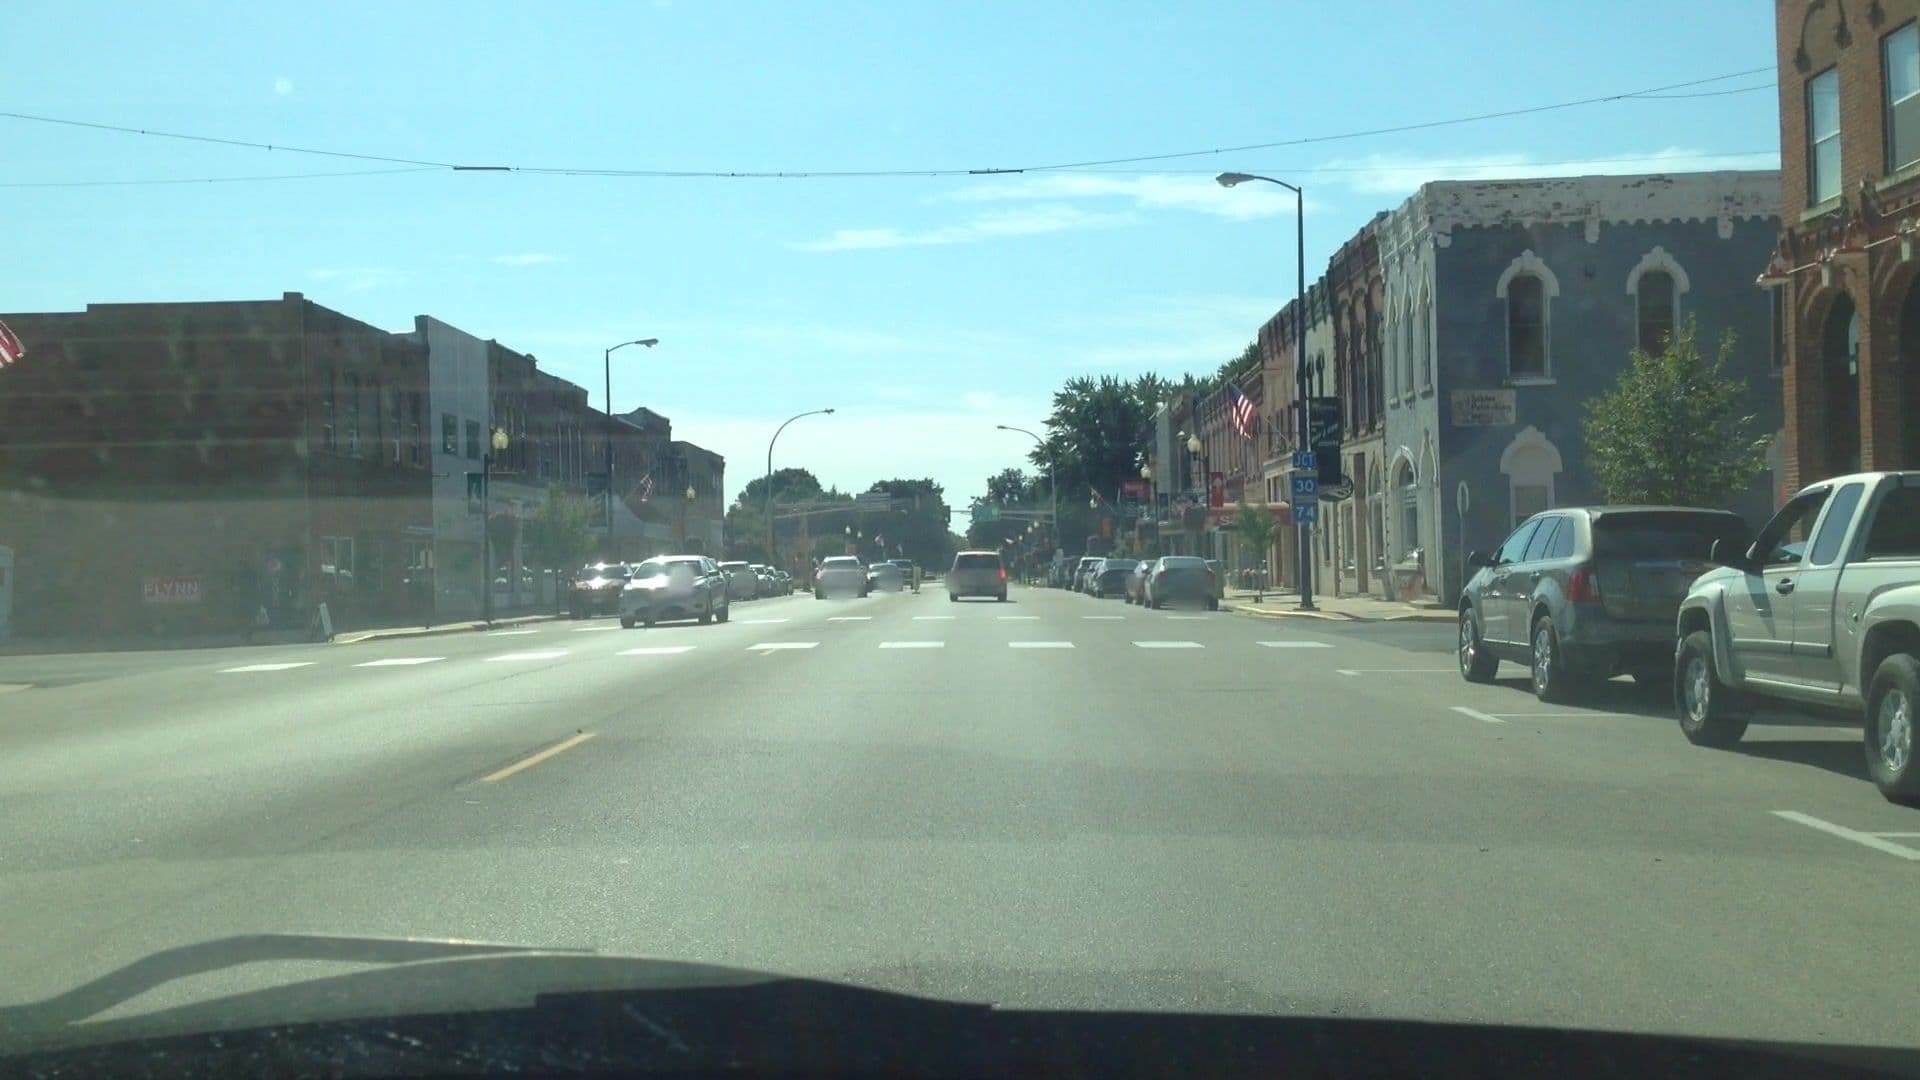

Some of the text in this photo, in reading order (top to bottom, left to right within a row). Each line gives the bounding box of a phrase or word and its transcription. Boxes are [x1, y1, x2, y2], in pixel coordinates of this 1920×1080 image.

[1296, 454, 1314, 466] JCT
[1296, 480, 1314, 493] 30
[1296, 507, 1314, 519] 74
[143, 581, 199, 595] FLYNN
